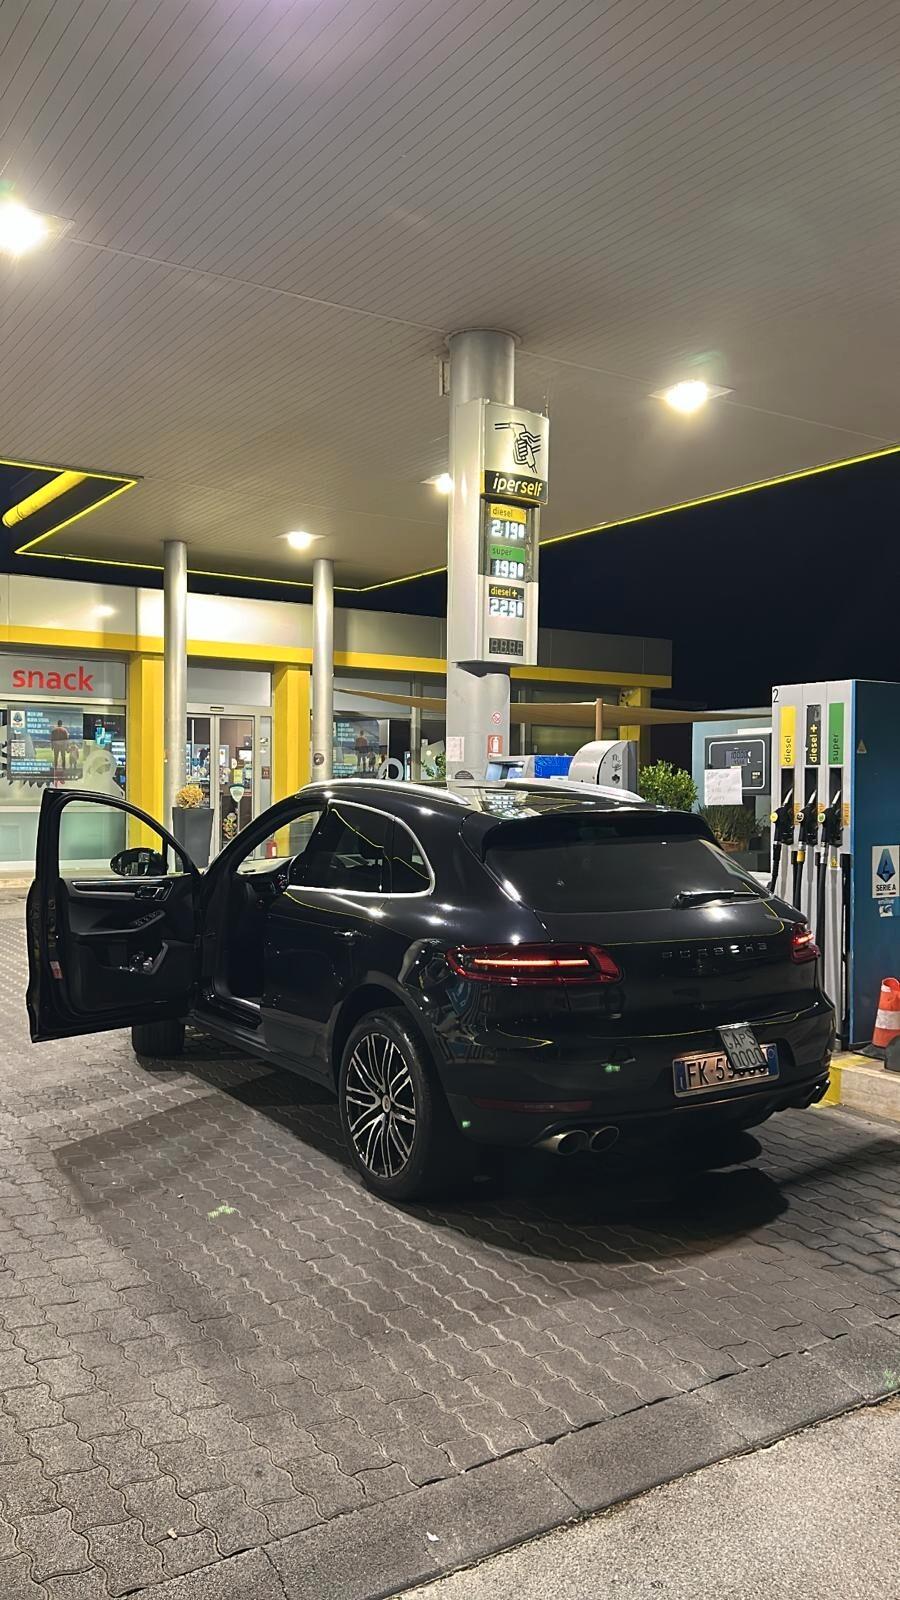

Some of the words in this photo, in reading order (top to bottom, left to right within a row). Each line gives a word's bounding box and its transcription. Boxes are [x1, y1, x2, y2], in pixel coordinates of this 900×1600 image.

[492, 473, 543, 497] iperself
[492, 506, 513, 518] diesel
[492, 547, 512, 557] super
[12, 665, 95, 692] snack
[772, 688, 780, 703] 2
[784, 735, 792, 763] diesel
[833, 734, 841, 762] super
[876, 884, 892, 892] SERIE
[686, 1060, 710, 1087] FK
